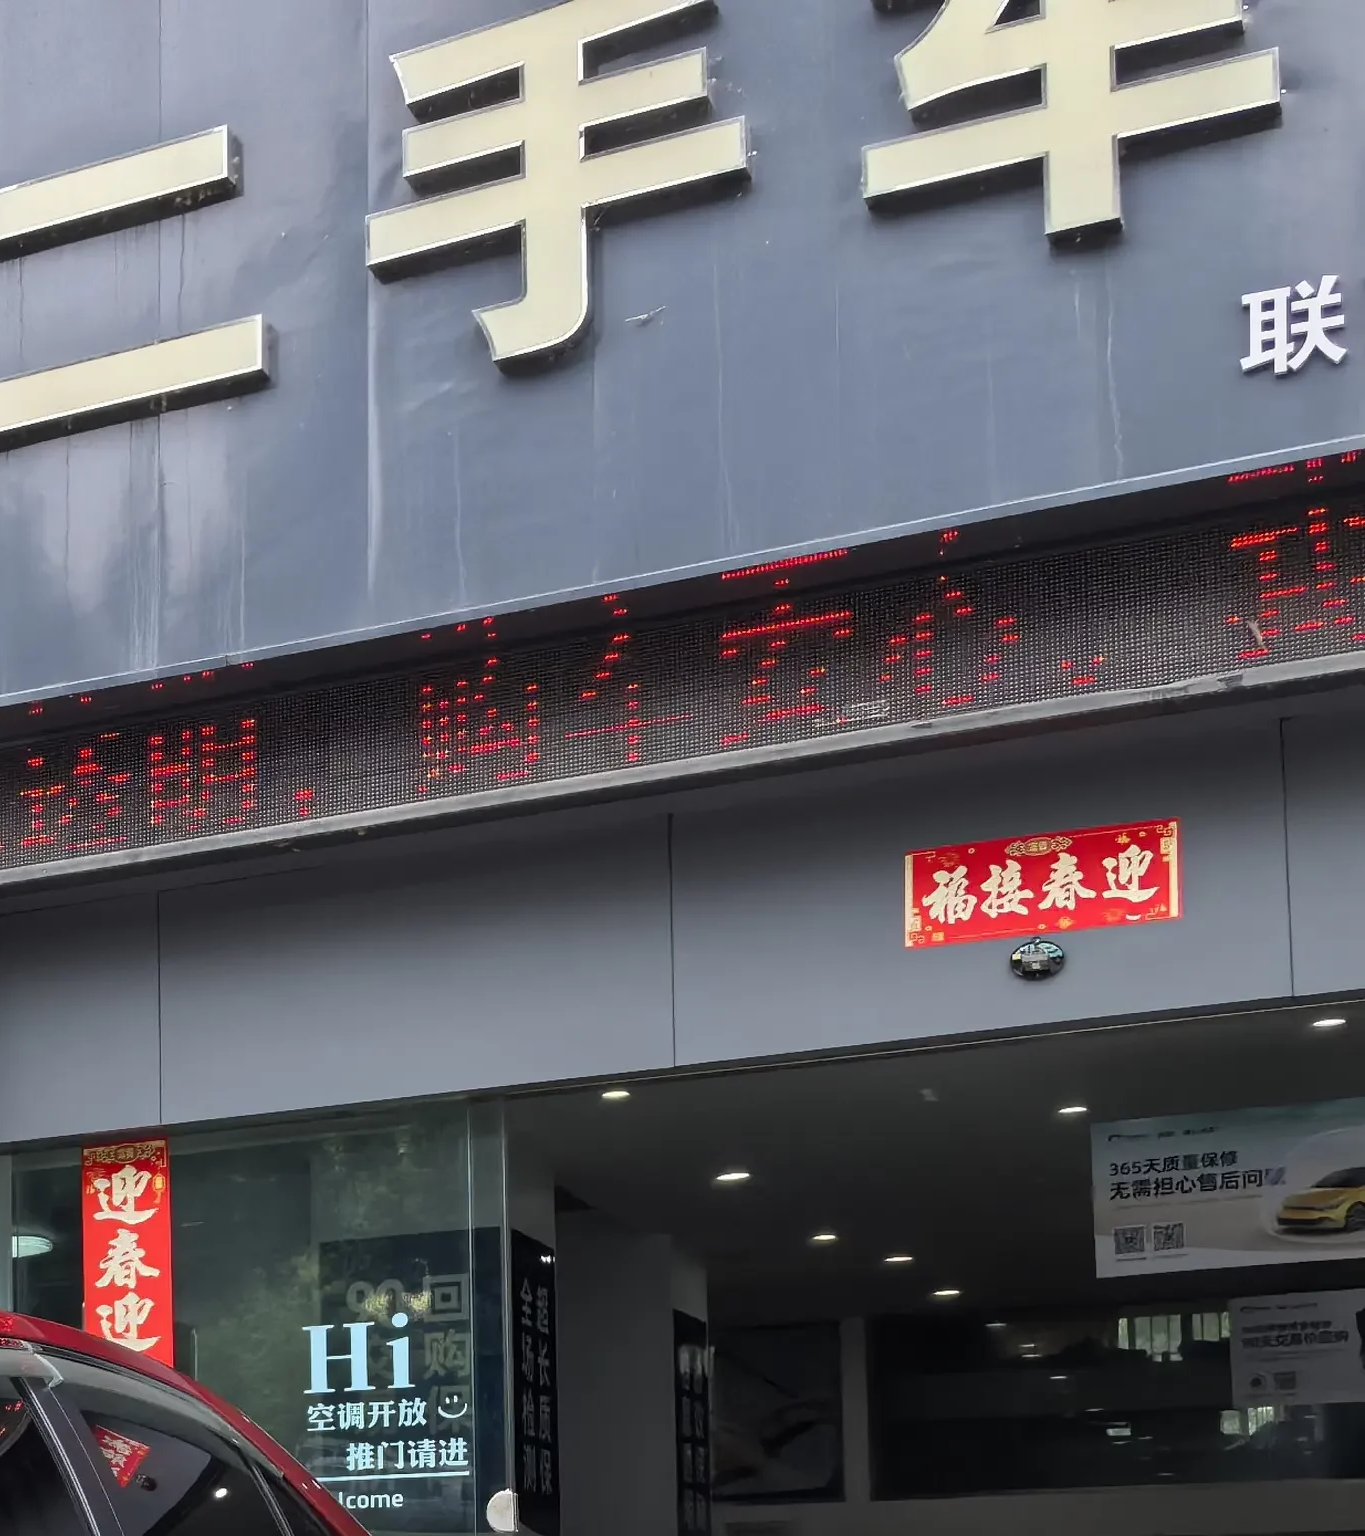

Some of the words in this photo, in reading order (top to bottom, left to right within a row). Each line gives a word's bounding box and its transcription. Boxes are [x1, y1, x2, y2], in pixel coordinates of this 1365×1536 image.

[1239, 274, 1349, 376] 联
[302, 1312, 416, 1394] Hi
[306, 1397, 428, 1432] 空调开放
[346, 1437, 469, 1472] 推门请进
[338, 1491, 404, 1509] lcome
